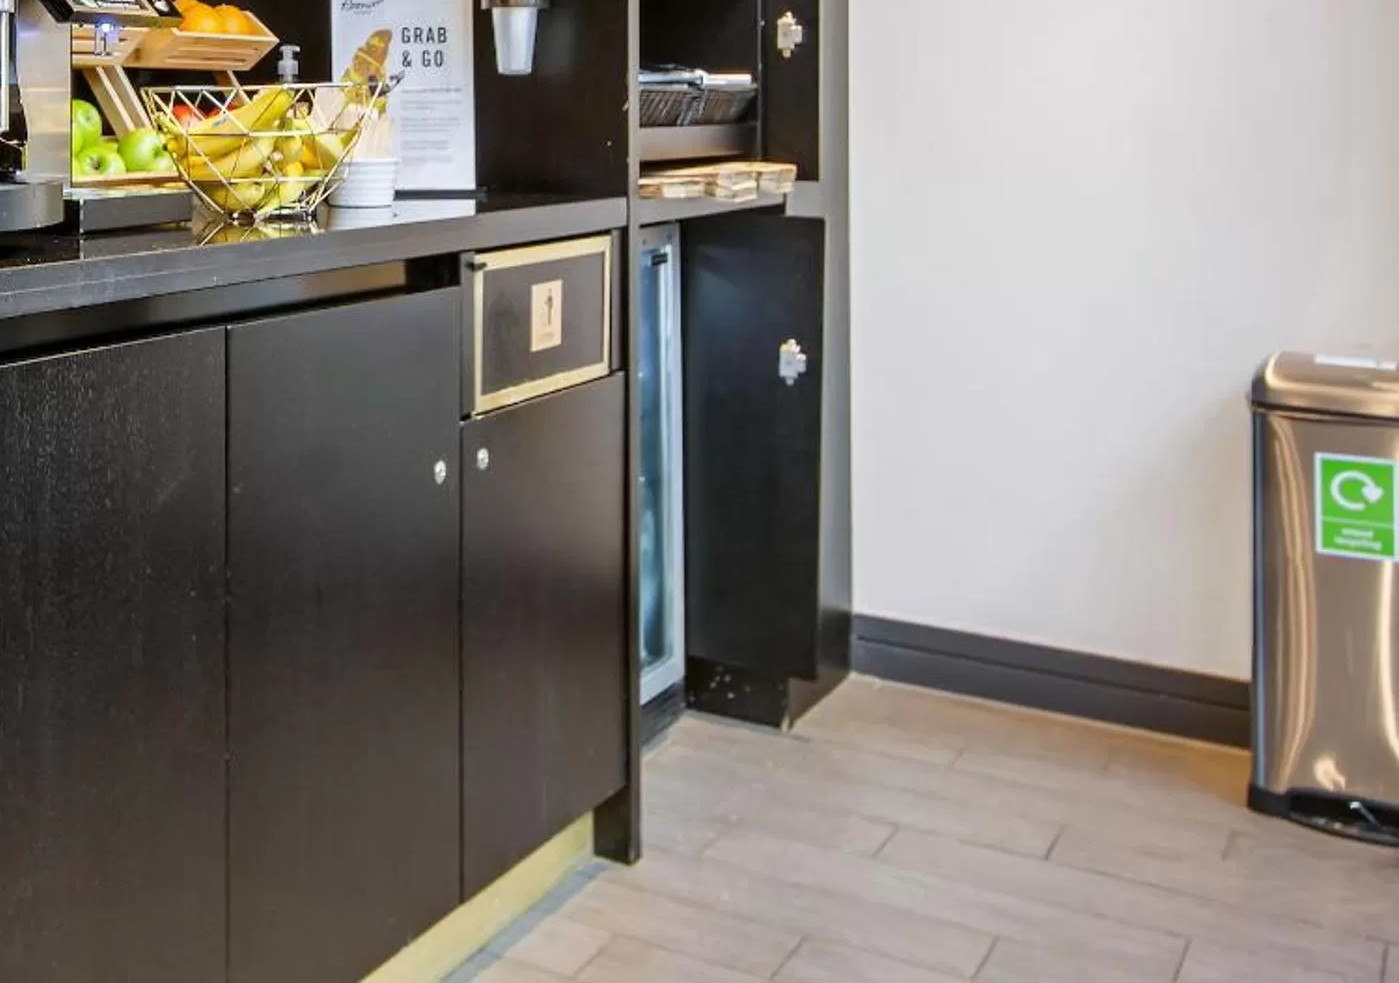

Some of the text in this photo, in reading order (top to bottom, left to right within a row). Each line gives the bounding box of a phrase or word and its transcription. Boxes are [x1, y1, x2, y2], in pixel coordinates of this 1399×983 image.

[401, 26, 448, 44] GRAB
[402, 50, 445, 68] & GO
